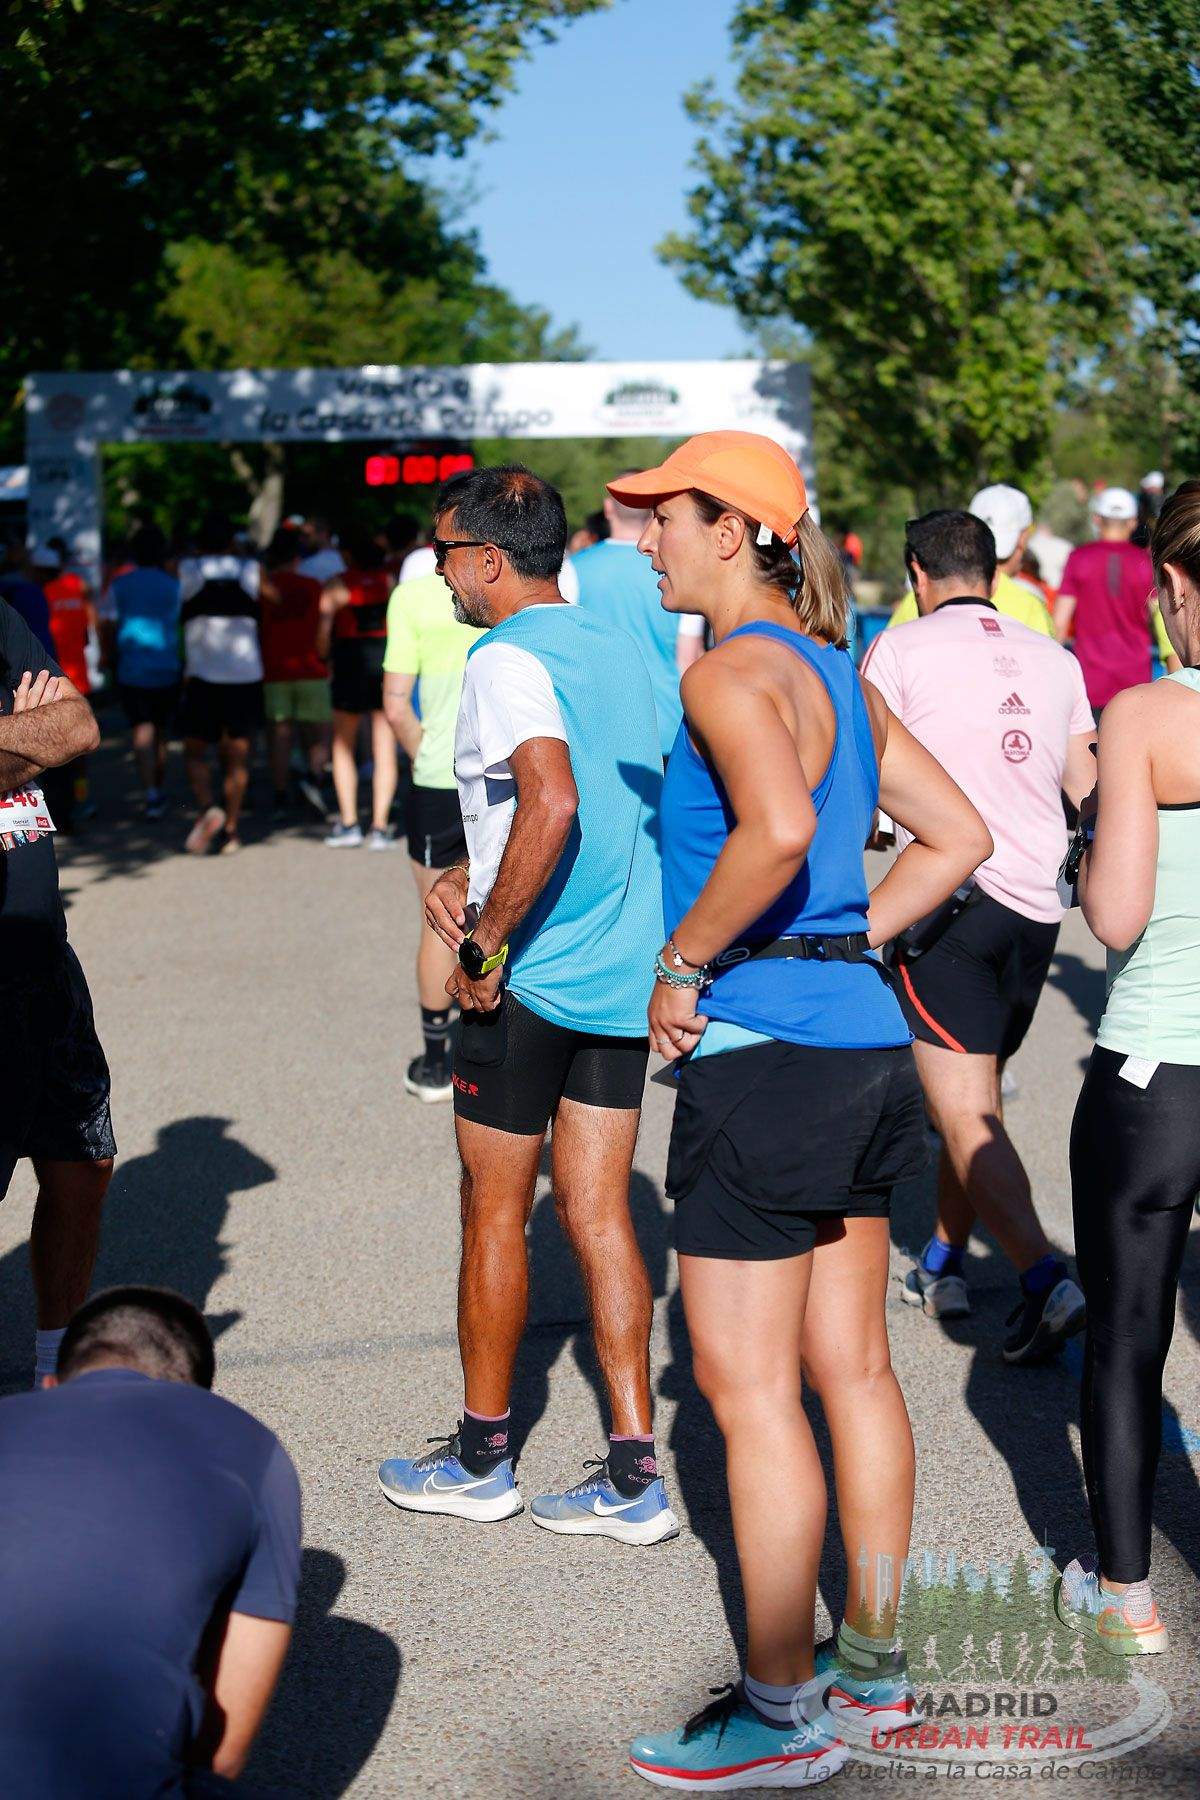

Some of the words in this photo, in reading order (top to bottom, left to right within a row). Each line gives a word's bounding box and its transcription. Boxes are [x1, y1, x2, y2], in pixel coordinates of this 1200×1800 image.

[998, 706, 1032, 715] adidas
[452, 1073, 479, 1097] KER
[781, 1723, 827, 1755] HOKA
